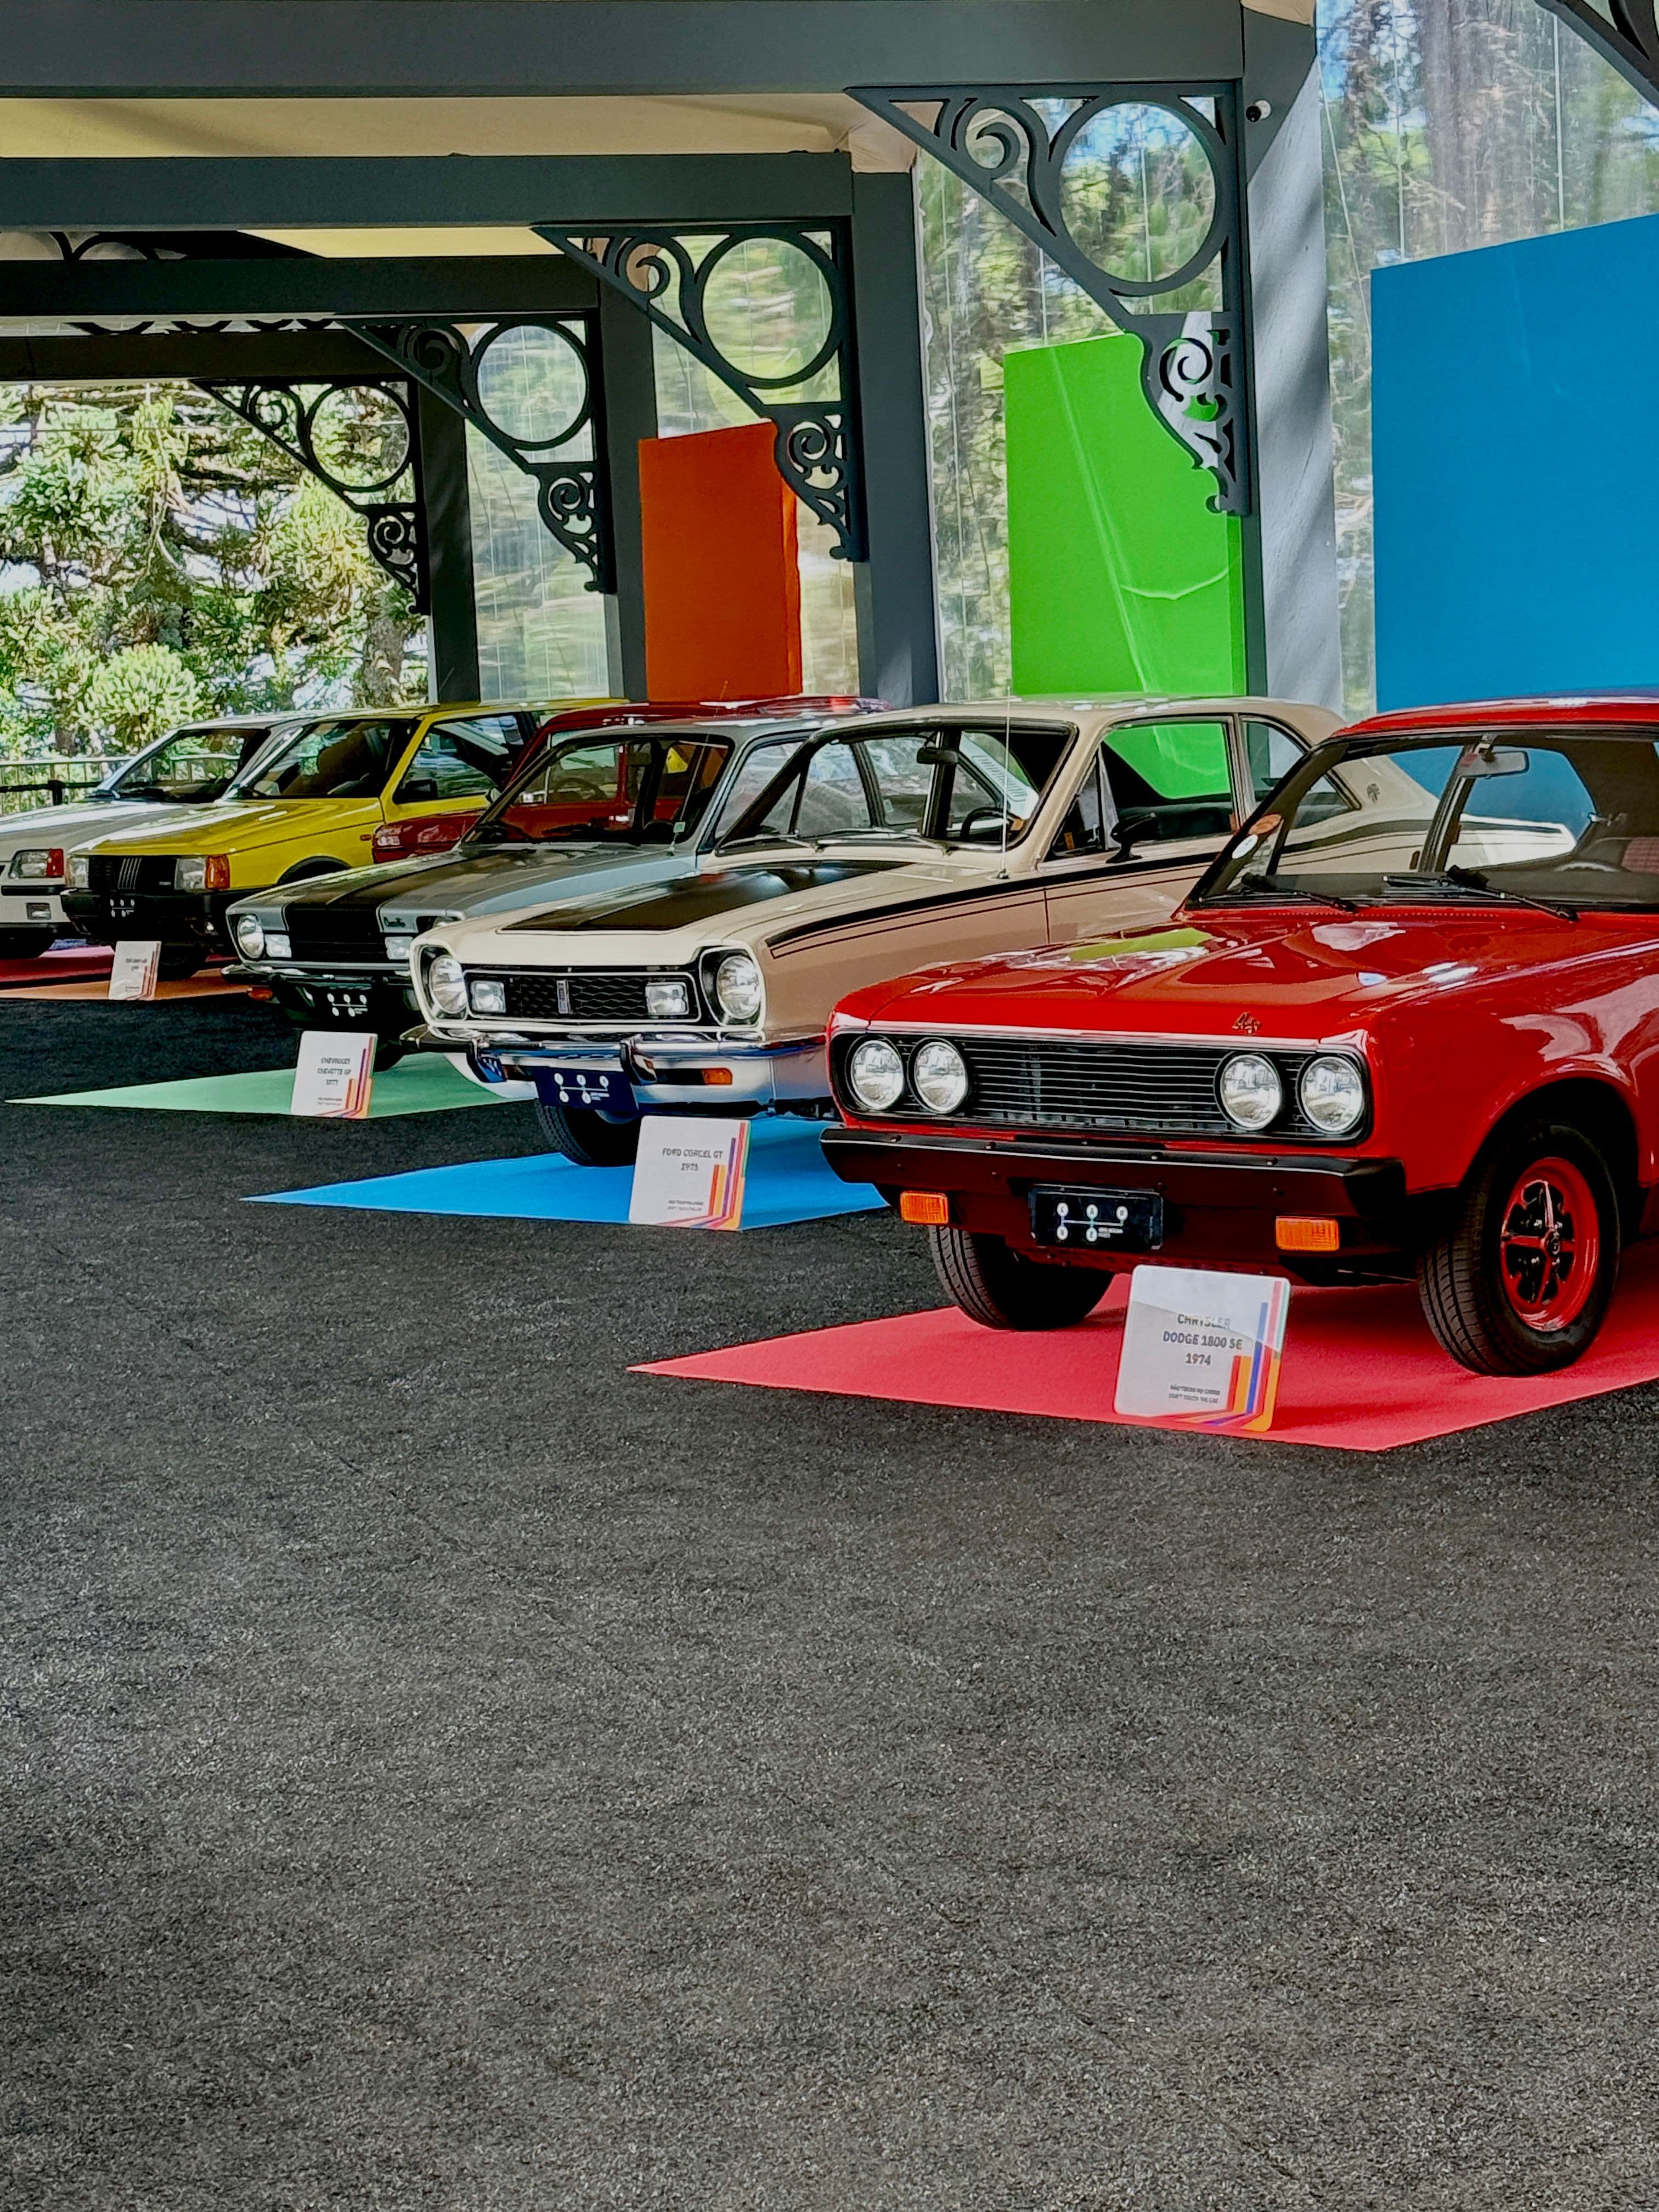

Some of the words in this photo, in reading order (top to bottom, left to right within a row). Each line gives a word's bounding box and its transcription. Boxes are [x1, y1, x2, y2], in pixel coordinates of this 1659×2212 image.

[662, 1148, 682, 1156] FORD
[684, 1149, 712, 1159] CORCEL
[713, 1150, 724, 1159] GT
[1163, 1331, 1199, 1345] DODGE
[1201, 1335, 1227, 1348] 1800
[1229, 1338, 1243, 1350] SE
[1186, 1352, 1211, 1365] 1974
